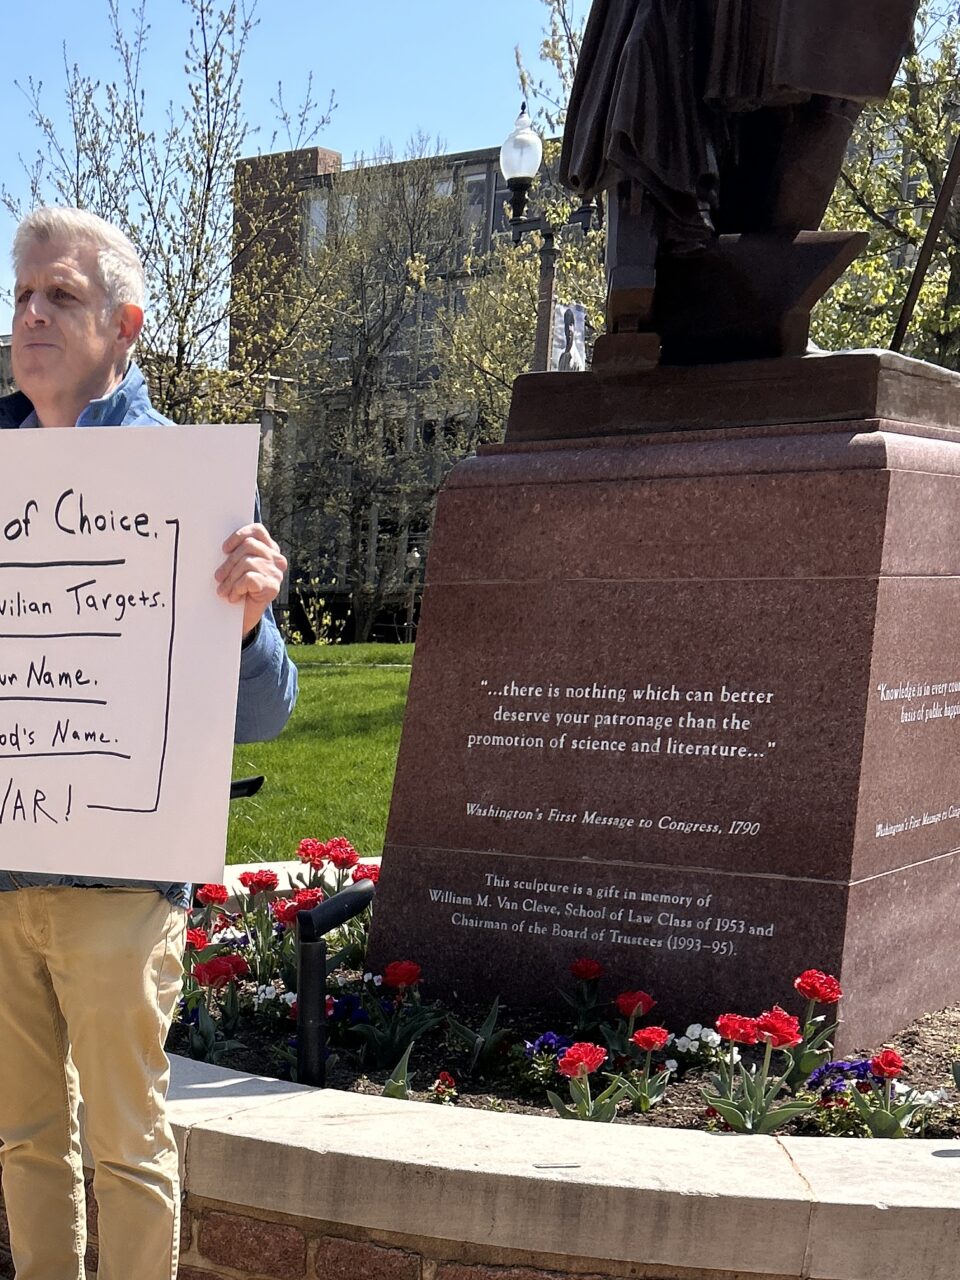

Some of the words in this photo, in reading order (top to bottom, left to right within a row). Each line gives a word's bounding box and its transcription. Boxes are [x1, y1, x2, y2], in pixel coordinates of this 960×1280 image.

[3, 499, 39, 541] of
[54, 488, 158, 539] Choice.
[65, 579, 166, 622] Targets.
[26, 655, 98, 689] Name.
[931, 682, 947, 696] every
[547, 683, 560, 698] is
[565, 682, 627, 702] nothing
[632, 683, 680, 701] which
[685, 690, 713, 702] can
[720, 685, 774, 703] better
[51, 718, 118, 747] Name.
[493, 705, 550, 723] deserve
[555, 712, 590, 726] your
[593, 713, 673, 730] patronage
[678, 711, 716, 729] than
[722, 713, 751, 730] the
[467, 733, 544, 748] promotion
[549, 733, 567, 748] of
[571, 736, 627, 752] science
[631, 737, 661, 753] and
[466, 802, 544, 821] Washington's
[547, 808, 578, 823] First
[581, 811, 635, 829] Message
[639, 818, 653, 828] to
[658, 815, 722, 834] Congress,
[728, 820, 761, 836] 1790
[484, 873, 510, 888] This
[513, 878, 570, 894] sculpture
[572, 883, 583, 895] is
[586, 887, 593, 896] a
[596, 885, 620, 900] gift
[623, 888, 637, 900] in
[640, 891, 693, 908] memory
[696, 894, 713, 908] of
[428, 888, 473, 906] William
[476, 893, 492, 908] M.
[497, 895, 518, 911] Van
[522, 898, 561, 916] Cleve,
[564, 902, 607, 920] School
[609, 908, 625, 921] of
[627, 909, 653, 924] Law
[657, 912, 693, 929] Class
[696, 917, 713, 931] of
[715, 918, 746, 934] 1953
[748, 923, 775, 937] and
[451, 912, 508, 931] Chairman
[511, 920, 526, 933] of
[528, 921, 548, 935] the
[552, 923, 588, 939] Board
[591, 928, 606, 941] of
[609, 929, 663, 949] Trustees
